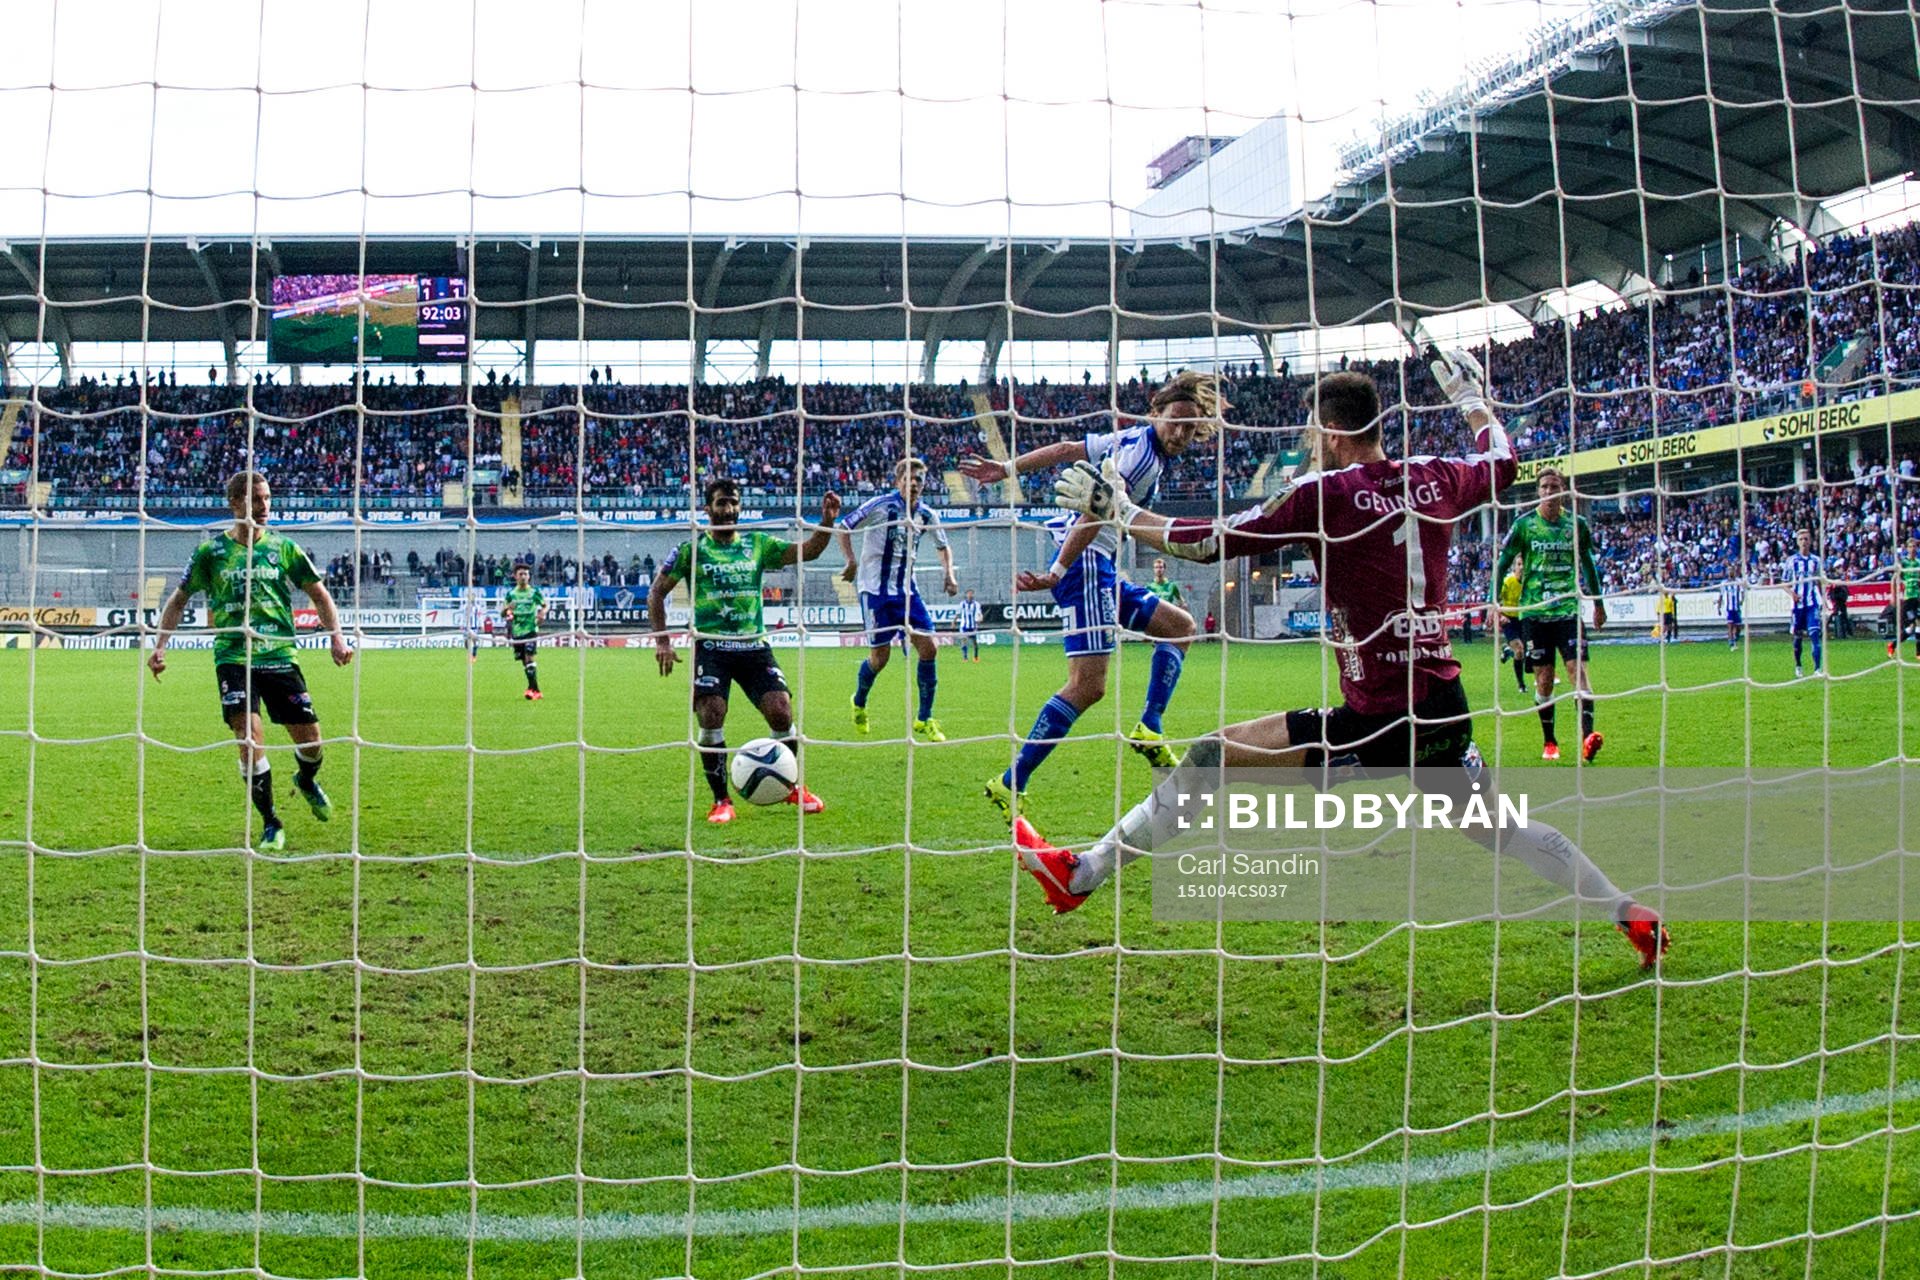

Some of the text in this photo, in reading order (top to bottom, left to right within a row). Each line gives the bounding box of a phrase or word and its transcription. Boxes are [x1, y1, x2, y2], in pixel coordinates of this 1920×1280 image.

[422, 306, 461, 321] 92:03
[1778, 404, 1861, 436] SOHLBERG
[1630, 434, 1696, 461] SOHLBERG
[1516, 459, 1564, 482] OHLBERG
[296, 511, 349, 521] SEPTEMBER
[367, 511, 404, 521] SVERIGE
[411, 511, 441, 521] POLEN
[614, 511, 656, 521] OKTOBER
[1392, 517, 1427, 609] 1
[384, 613, 422, 625] TYRES
[1003, 605, 1062, 619] GAMLA
